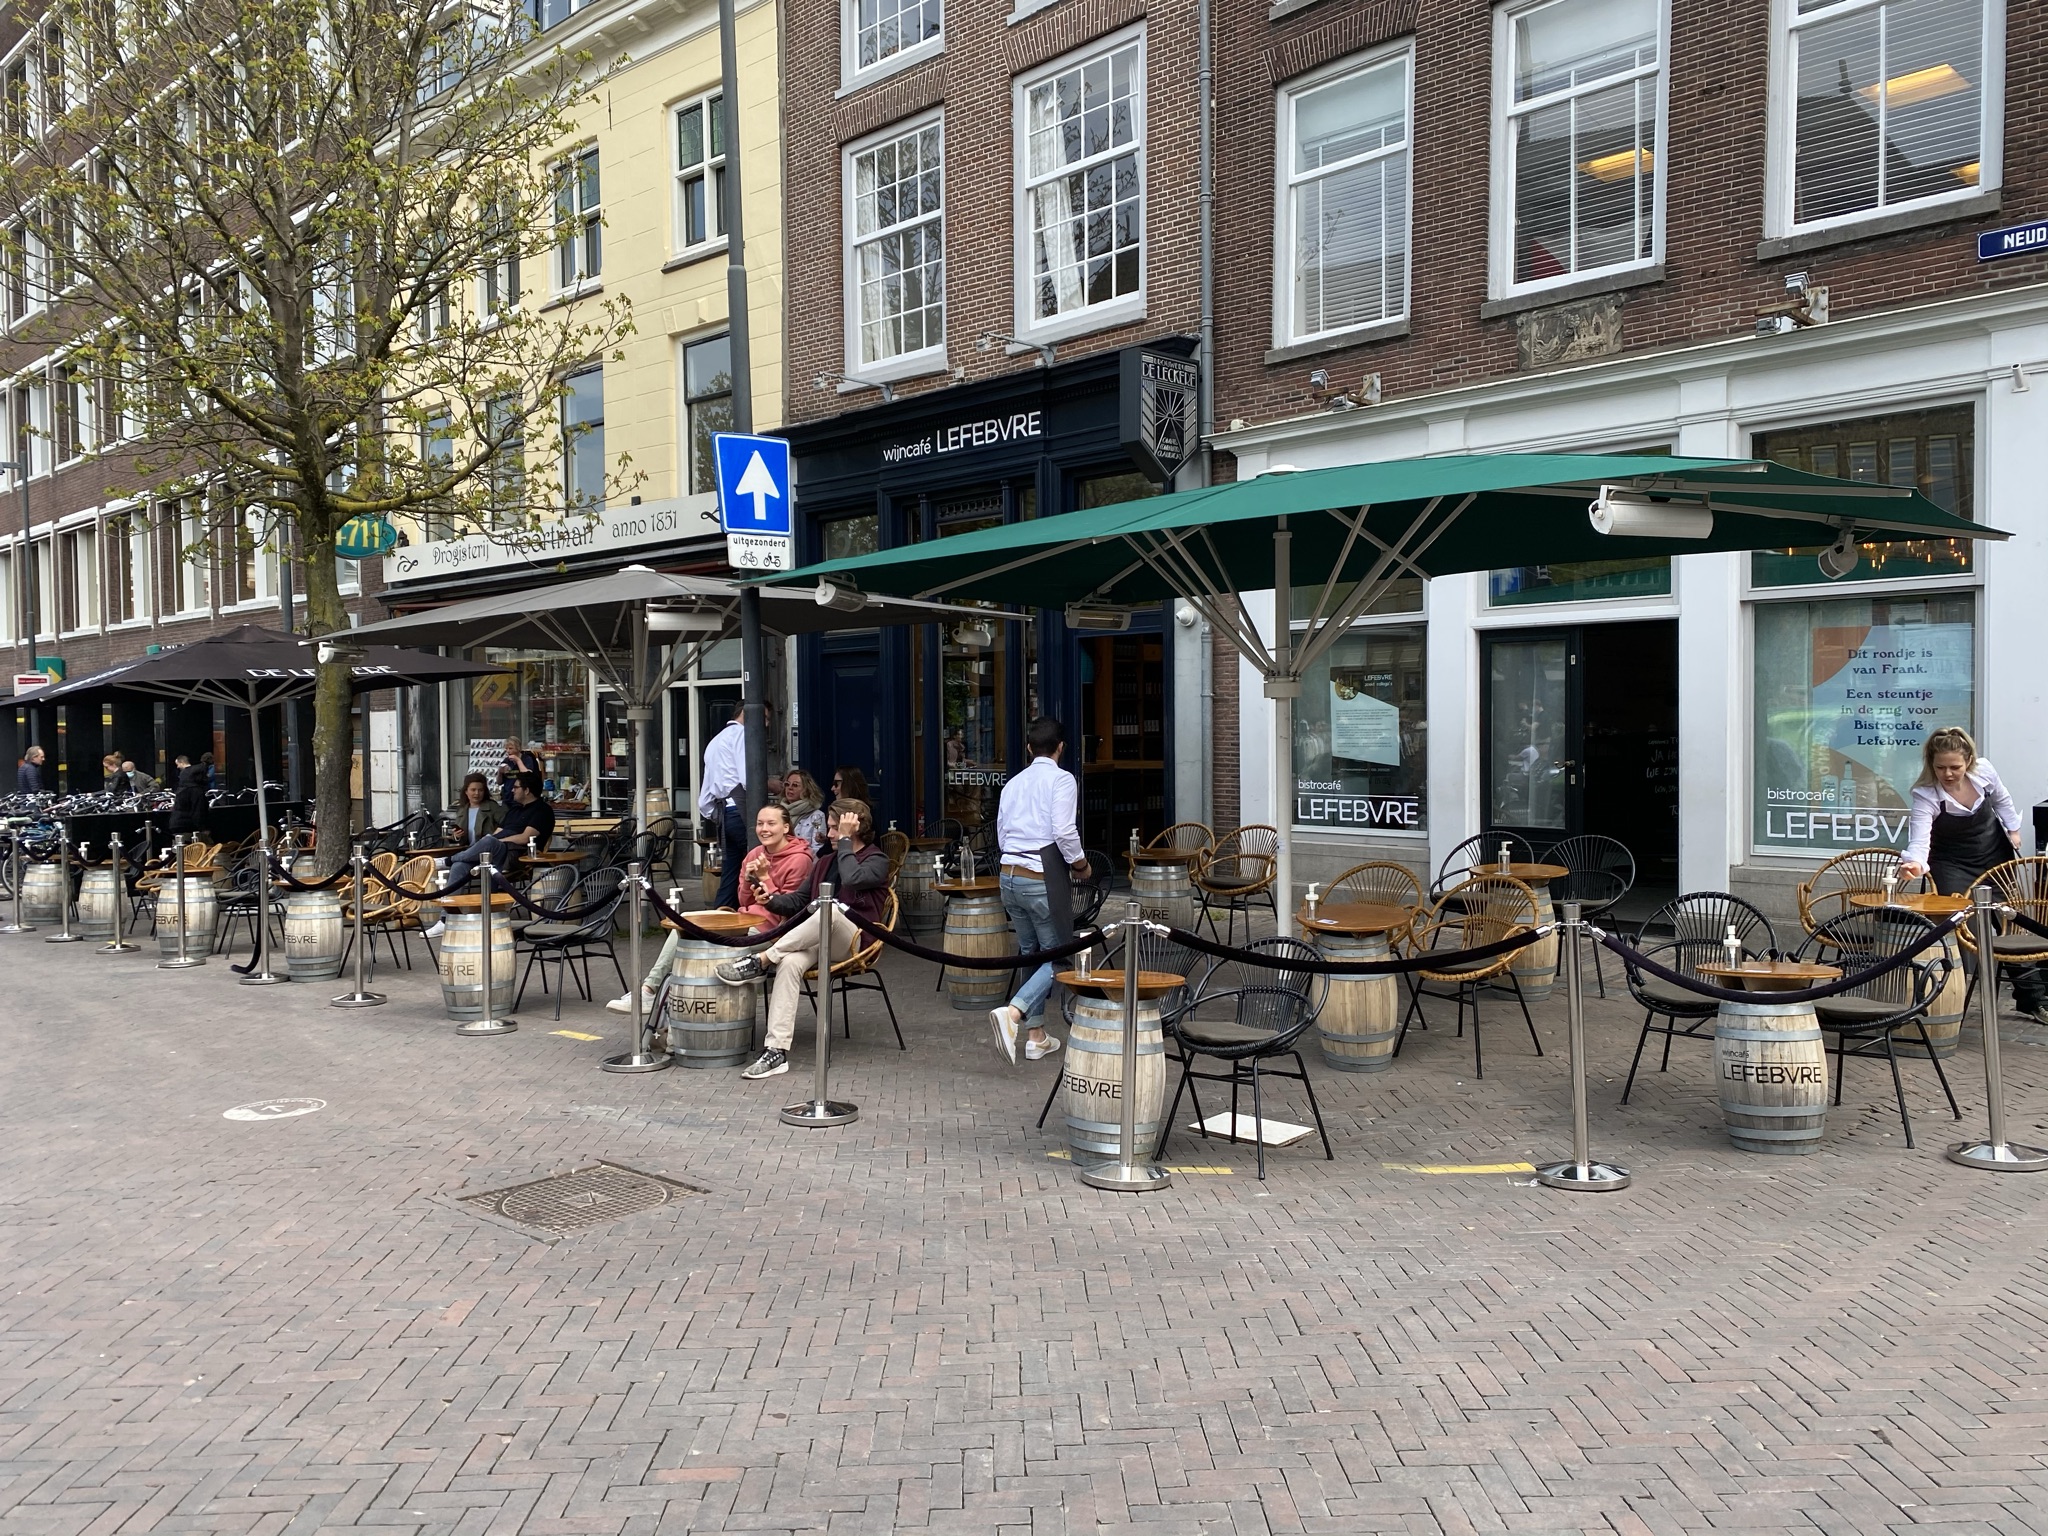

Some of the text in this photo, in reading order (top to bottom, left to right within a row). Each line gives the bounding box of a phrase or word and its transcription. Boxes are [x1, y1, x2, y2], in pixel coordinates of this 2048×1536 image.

[2004, 227, 2047, 249] NEUD
[1142, 362, 1196, 387] DE LECKERE
[883, 411, 1041, 462] wijncafé LEFEBVRE
[612, 518, 647, 538] anno
[651, 510, 677, 532] 1851
[733, 536, 786, 548] uitgezonderd
[1848, 648, 1933, 660] Dit rondje is
[246, 665, 398, 677] DE LEERE
[1853, 664, 1928, 674] van Frank.
[1846, 688, 1934, 701] Een steuntje
[1841, 705, 1938, 717] in de rug voor
[1854, 720, 1924, 730] Bistrocafé
[1857, 735, 1920, 746] Lefebvre.
[948, 771, 1007, 787] LEFEBVRE
[1298, 779, 1341, 791] bistrocafé
[1767, 787, 1835, 802] bistrocafé
[1297, 797, 1419, 825] LEFEBVRE
[1766, 810, 1911, 844] LEFEBV
[1722, 1049, 1749, 1059] wijncafé
[1722, 1062, 1822, 1085] LEFEBVRE
